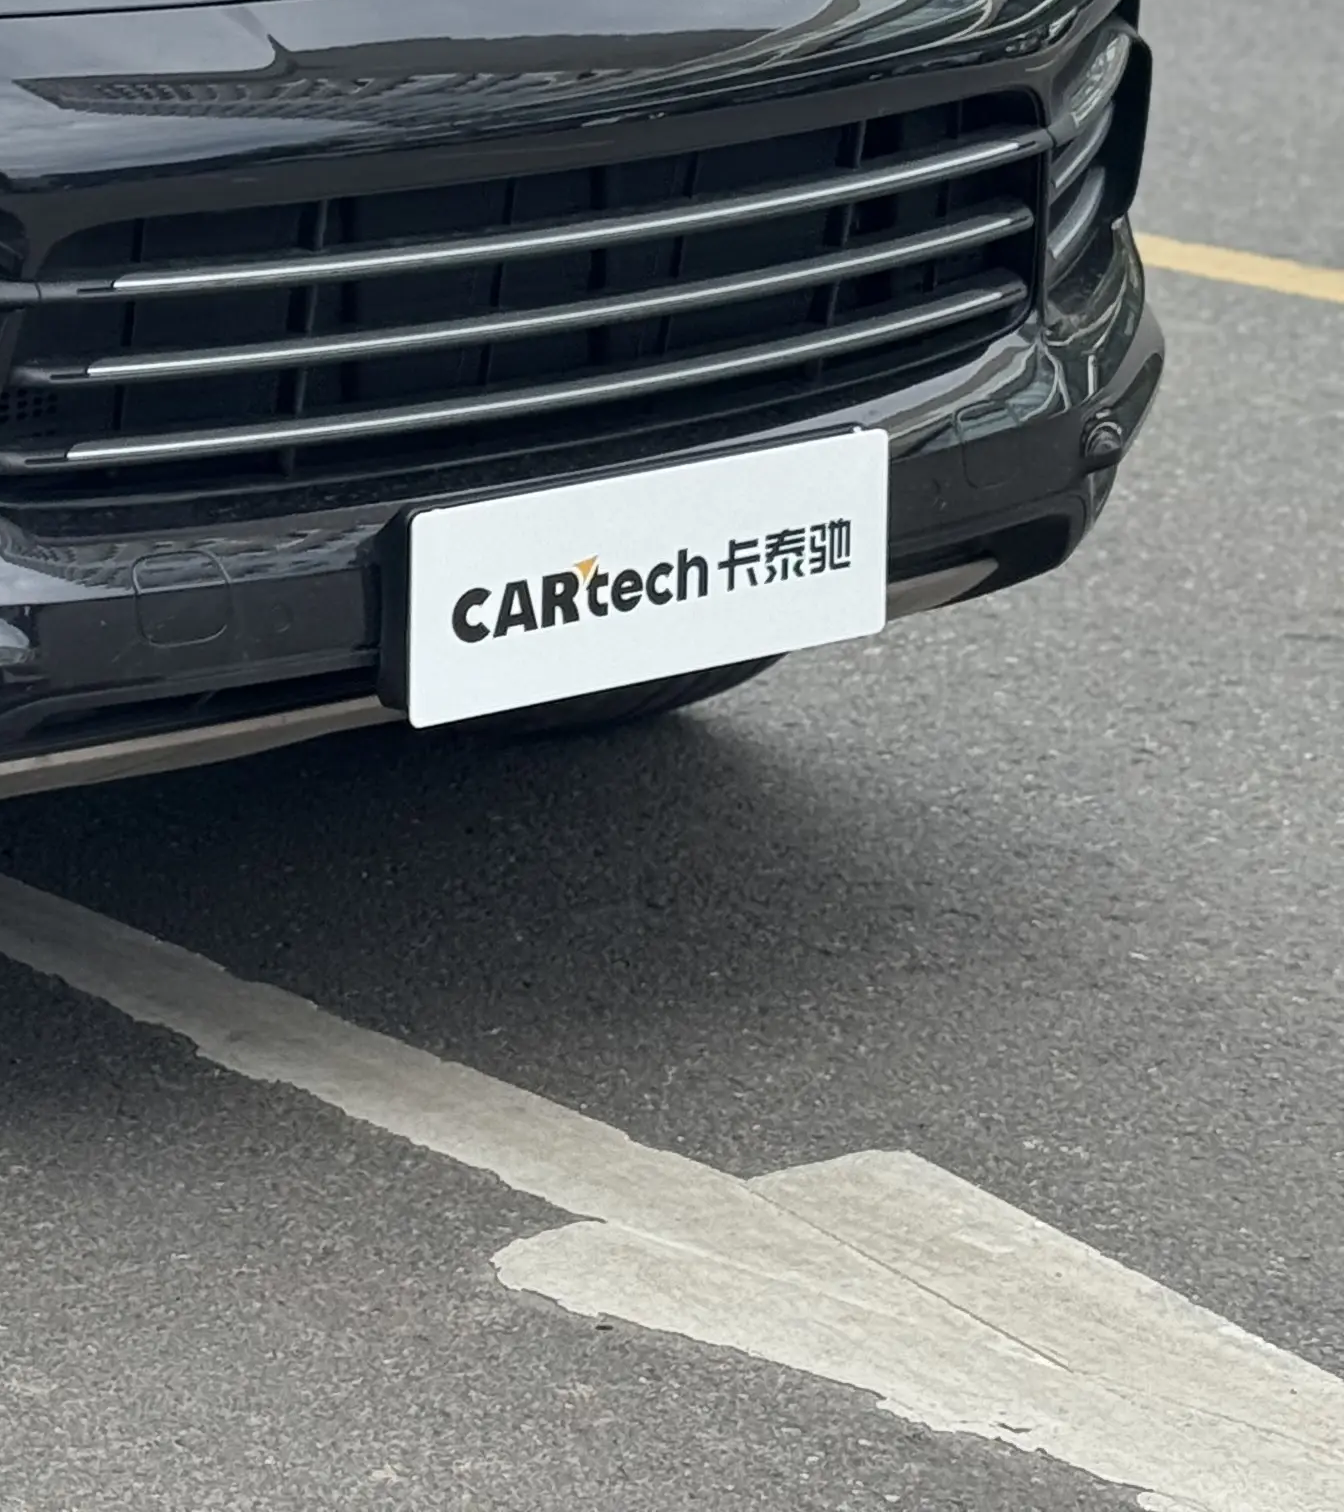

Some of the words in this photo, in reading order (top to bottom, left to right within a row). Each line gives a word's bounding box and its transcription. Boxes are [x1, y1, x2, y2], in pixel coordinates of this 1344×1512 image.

[452, 548, 708, 643] CARtech
[718, 518, 851, 591] 卡泰驰
